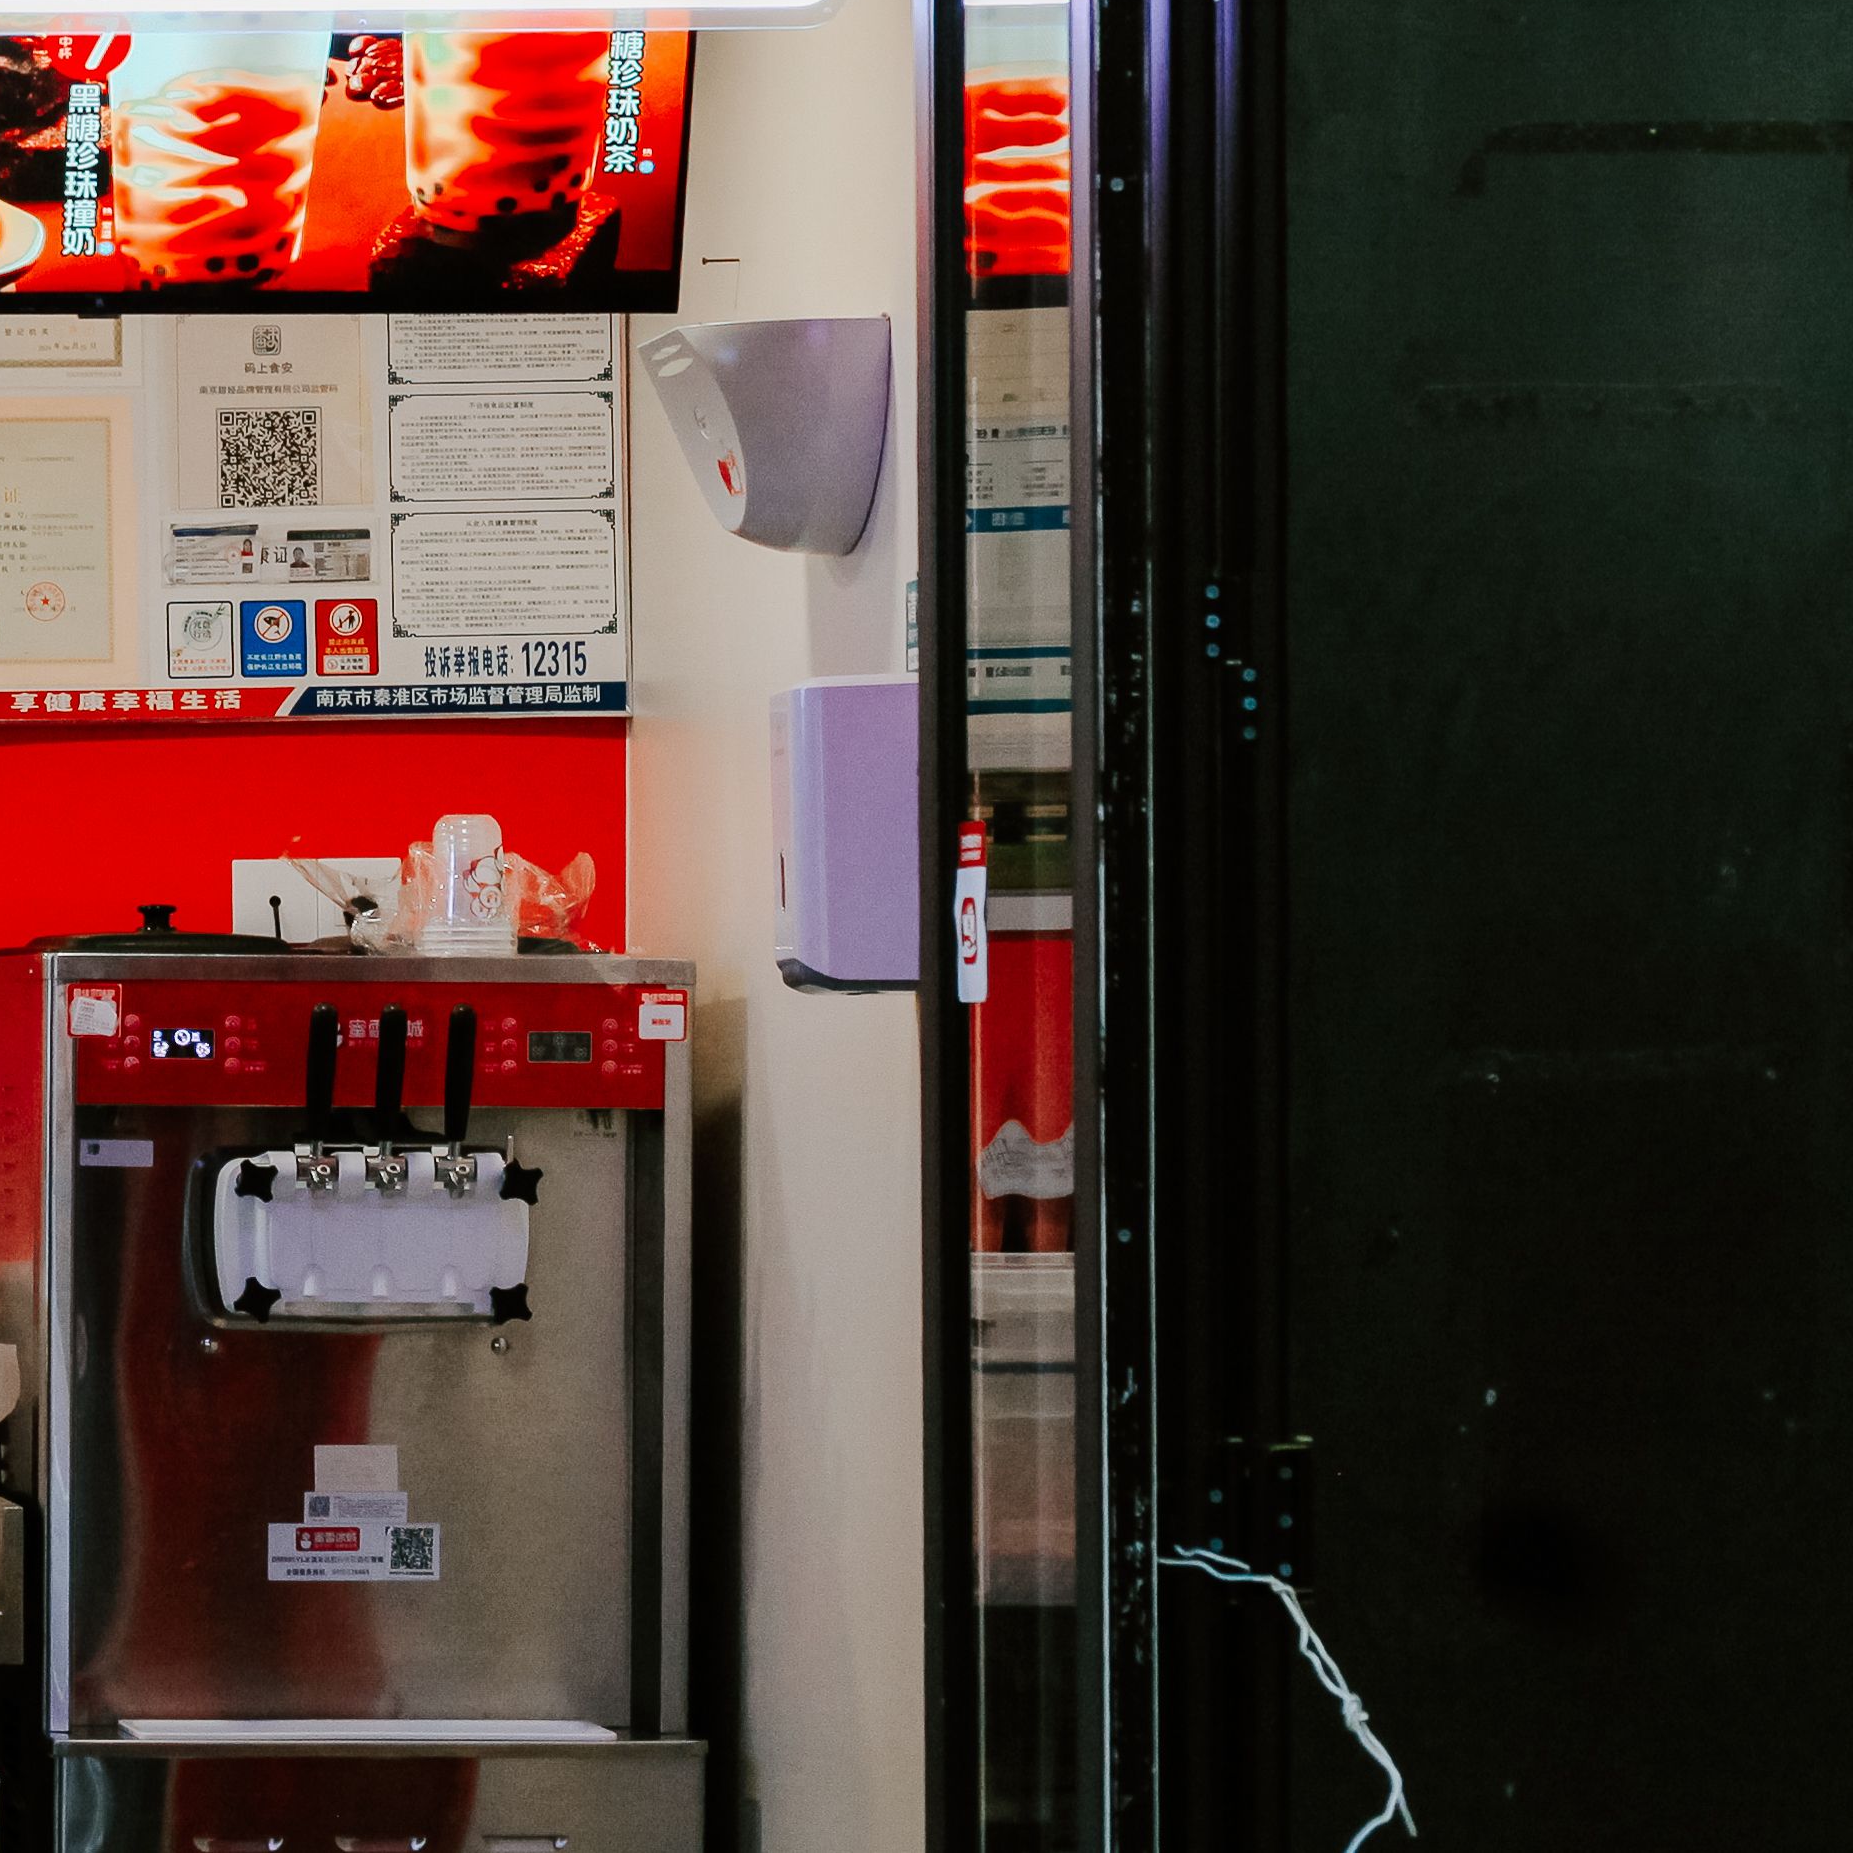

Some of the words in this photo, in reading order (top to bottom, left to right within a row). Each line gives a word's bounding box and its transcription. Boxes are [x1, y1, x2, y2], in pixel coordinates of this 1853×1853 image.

[62, 83, 103, 257] 黑糖珍珠撞奶
[245, 362, 293, 374] 码上食安
[521, 640, 588, 677] 12315
[10, 690, 243, 715] 享健康幸福生活
[315, 682, 602, 709] 南京市秦淮区市场监督管理局监制
